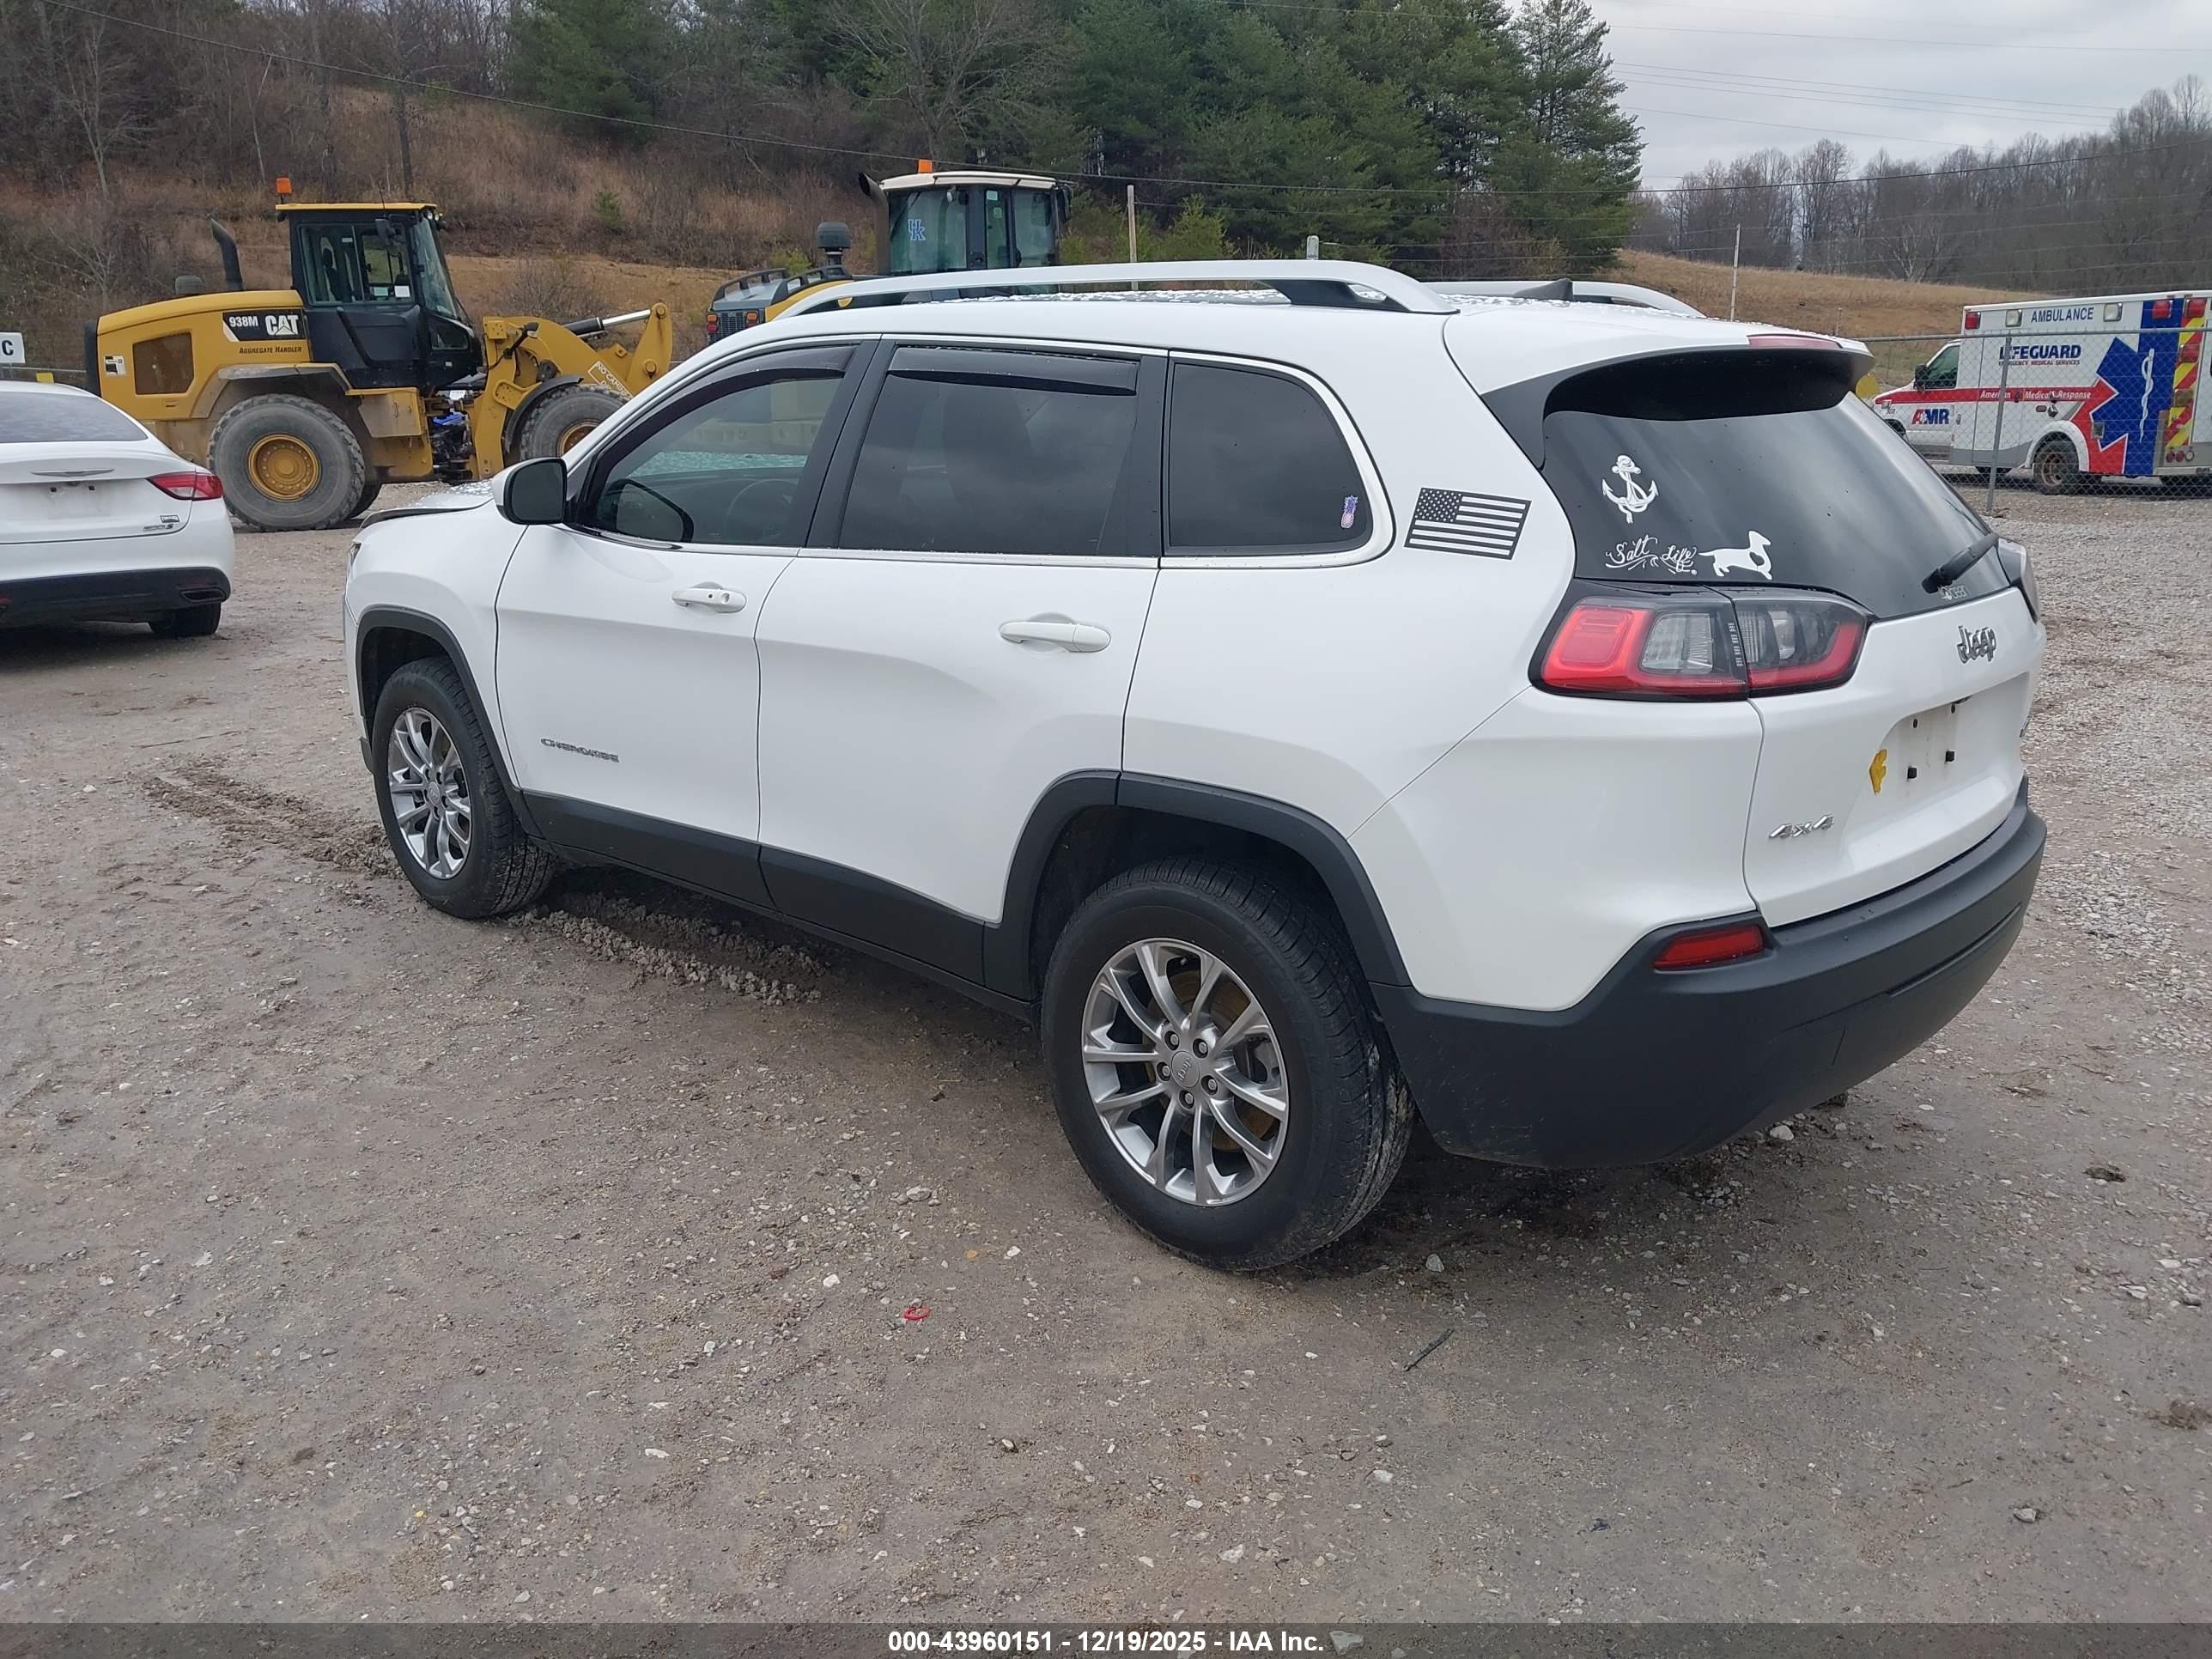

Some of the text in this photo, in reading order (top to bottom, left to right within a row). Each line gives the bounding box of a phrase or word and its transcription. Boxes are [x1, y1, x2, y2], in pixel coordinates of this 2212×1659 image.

[2031, 307, 2094, 323] AMBULANCE
[228, 314, 299, 336] 938M CAT
[1999, 344, 2081, 360] LFEGUARD
[2024, 390, 2051, 399] Medical
[2057, 390, 2091, 399] Response
[1911, 408, 1950, 424] AMR
[1605, 533, 1697, 573] Salt Life
[1957, 625, 1997, 664] Jeep
[540, 738, 620, 763] CHEROKEE
